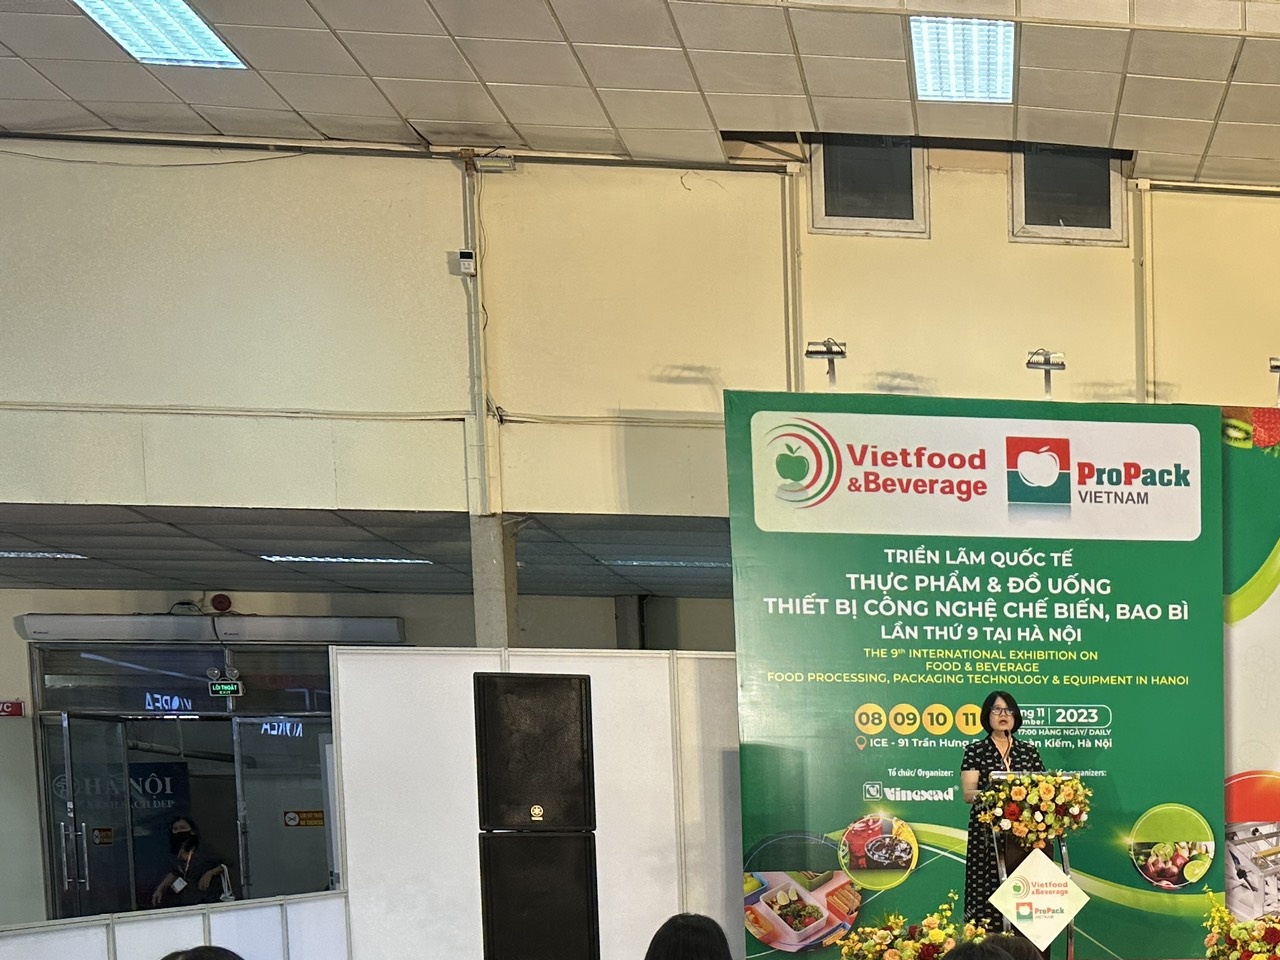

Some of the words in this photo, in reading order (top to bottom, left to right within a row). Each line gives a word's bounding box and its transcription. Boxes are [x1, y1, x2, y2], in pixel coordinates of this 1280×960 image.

[846, 443, 986, 470] Vietfood
[1077, 462, 1190, 487] ProPack
[847, 471, 987, 502] &Beverage
[1078, 490, 1149, 504] VIETNAM
[884, 545, 939, 564] TRIỂN
[946, 548, 985, 564] LÃM
[991, 548, 1045, 568] QUỐC
[1050, 549, 1072, 566] TẾ
[846, 572, 908, 594] THỰC
[915, 570, 981, 593] PHẨM
[986, 577, 1002, 593] &
[1007, 573, 1041, 593] ĐỒ
[1048, 574, 1110, 594] UỐNG
[763, 593, 829, 615] THIẾT
[836, 599, 856, 619] BỊ
[864, 596, 929, 616] CÔNG
[936, 598, 997, 621] NGHỆ
[1004, 598, 1048, 618] CHẾ
[1055, 598, 1109, 622] BIẾN,
[1117, 604, 1161, 619] BAO
[1169, 601, 1188, 619] BÌ
[881, 621, 918, 639] LẦN
[923, 623, 963, 640] THỨ
[967, 627, 978, 640] 9
[983, 627, 1011, 643] TẠI
[1018, 625, 1044, 641] HÀ
[1049, 625, 1081, 644] NỘI
[864, 648, 888, 658] THE
[909, 649, 1006, 659] INTERNATIONAL
[1010, 650, 1076, 660] EXHIBITION
[1080, 651, 1097, 660] ON
[926, 662, 961, 671] FOOD
[964, 662, 972, 671] &
[976, 662, 1039, 672] BEVERAGE
[767, 672, 804, 682] FOOD
[808, 673, 890, 684] PROCESSING,
[893, 674, 964, 684] PACKAGING
[967, 674, 1049, 685] TECHNOLOGY
[1052, 676, 1060, 685] &
[1063, 676, 1133, 686] EQUIPMENT
[1136, 676, 1148, 685] IN
[1151, 676, 1189, 685] HANOI
[858, 711, 883, 726] 08
[893, 711, 917, 726] 09
[927, 712, 947, 726] 10
[962, 712, 977, 726] 11
[1036, 707, 1045, 717] 11
[1055, 708, 1098, 723] 2023
[1039, 727, 1061, 735] HÀNG
[870, 738, 889, 747] ICE
[898, 738, 909, 747] 91
[1077, 738, 1091, 748] Hà
[1094, 738, 1112, 749] Nội
[917, 769, 954, 778] Organizer:
[883, 787, 954, 801] Vinexad
